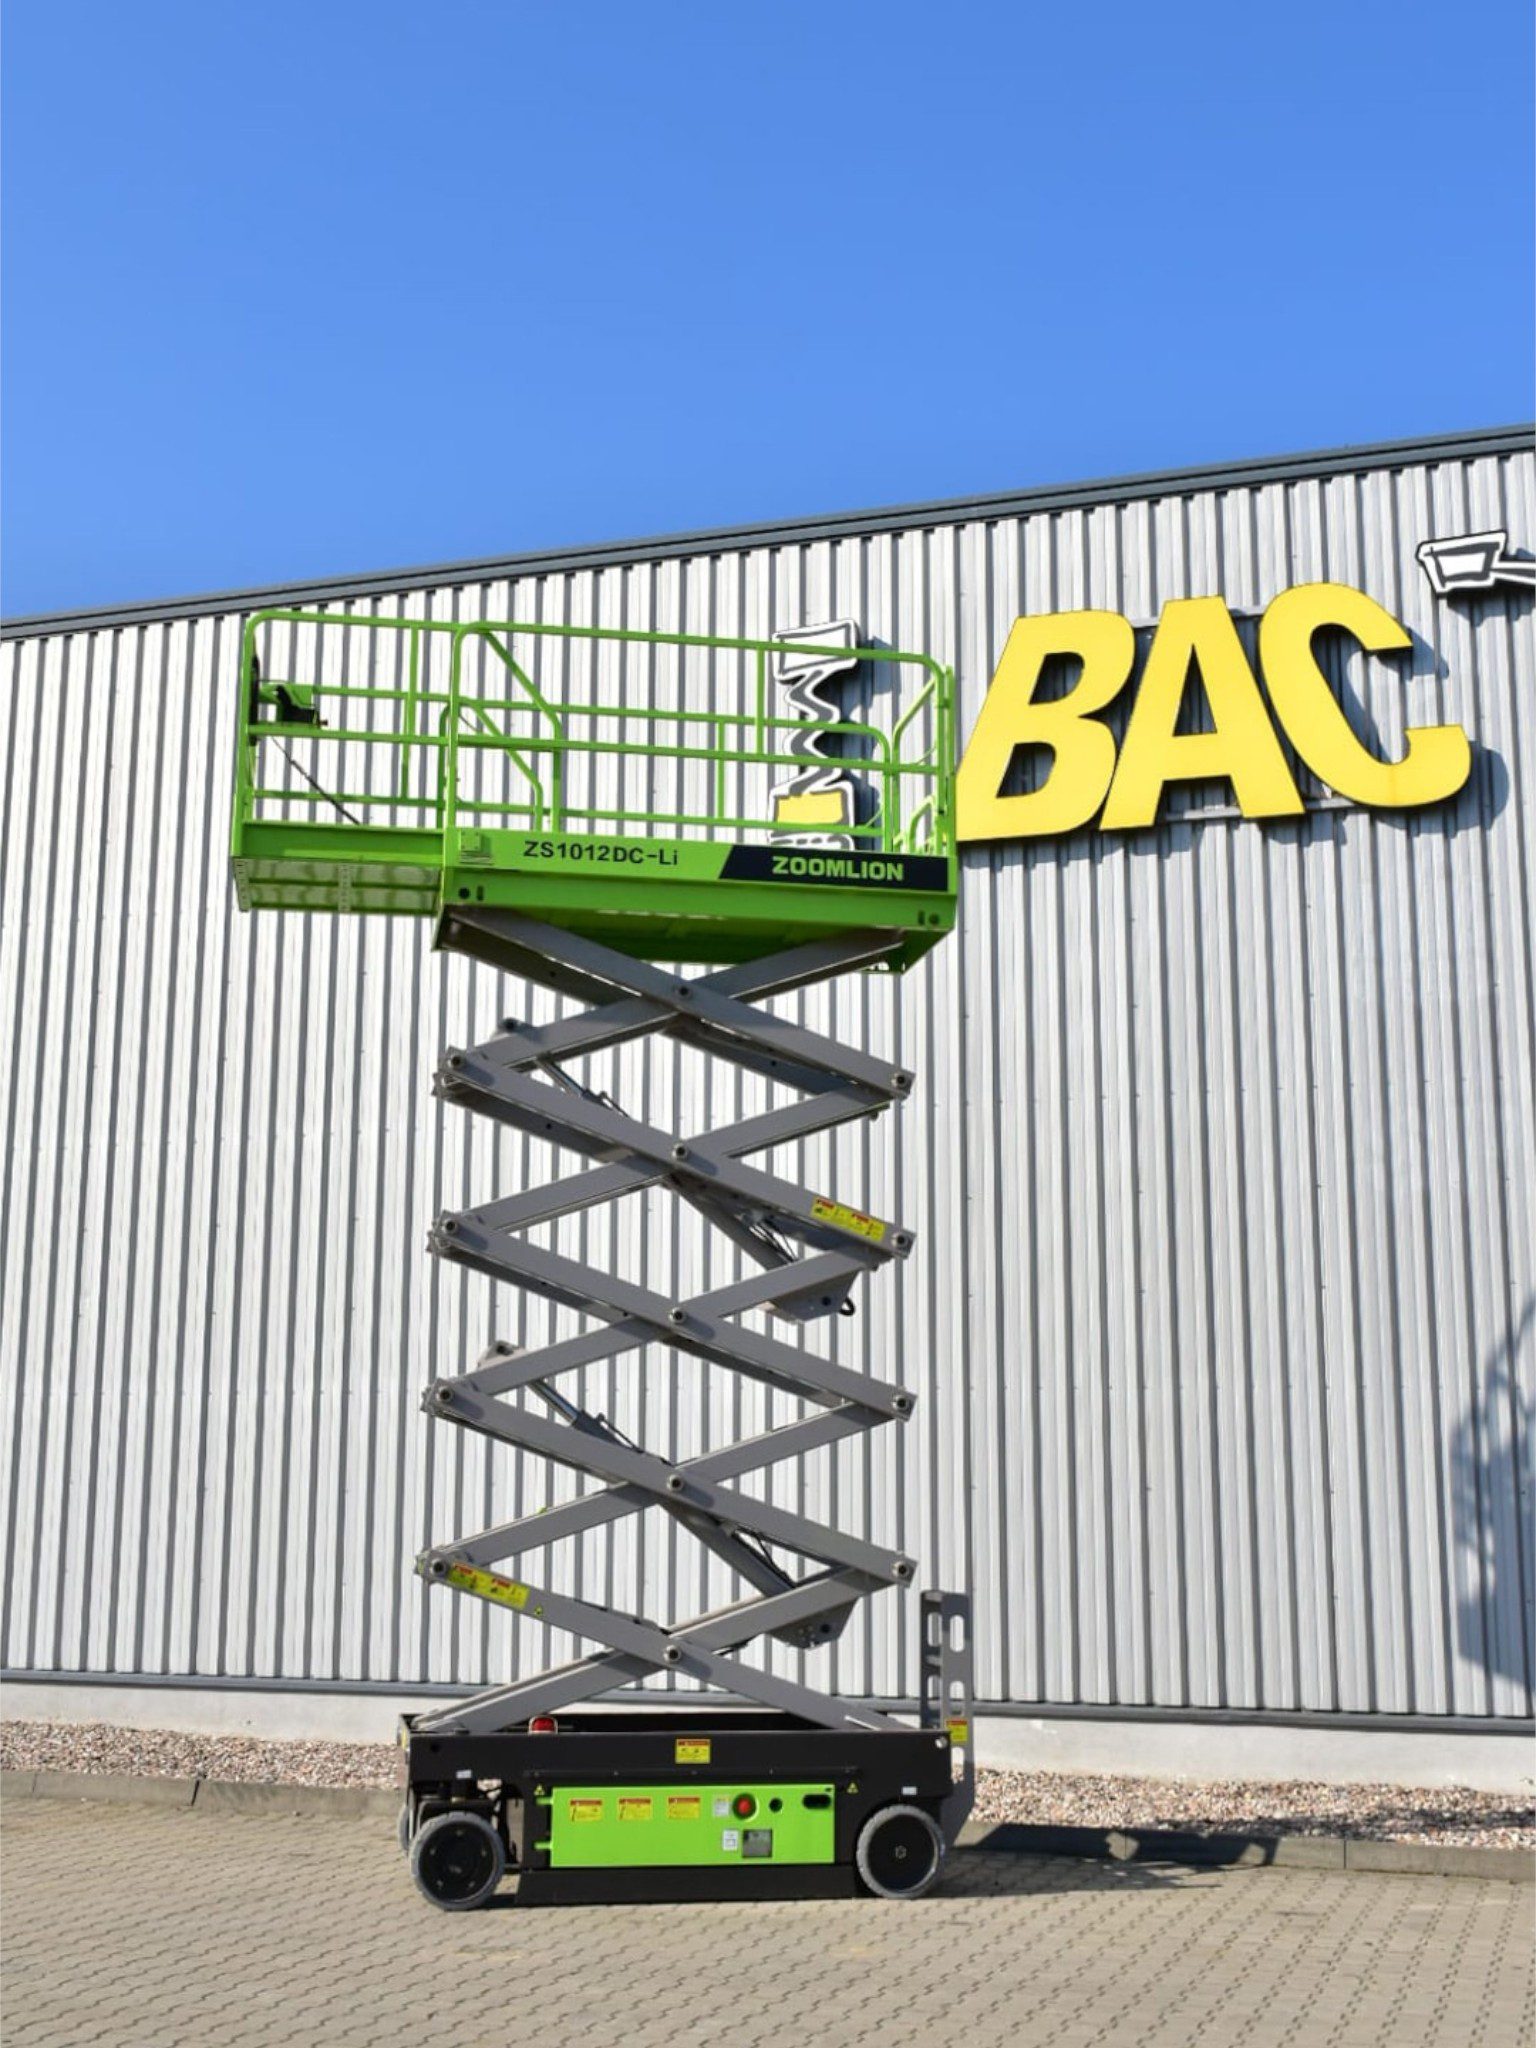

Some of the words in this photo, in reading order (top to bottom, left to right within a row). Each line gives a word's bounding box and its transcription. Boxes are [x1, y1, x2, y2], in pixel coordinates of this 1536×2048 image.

[957, 583, 1471, 841] BAC
[523, 841, 678, 866] ZS1012DC-Li
[772, 856, 904, 882] ZOOMLION
